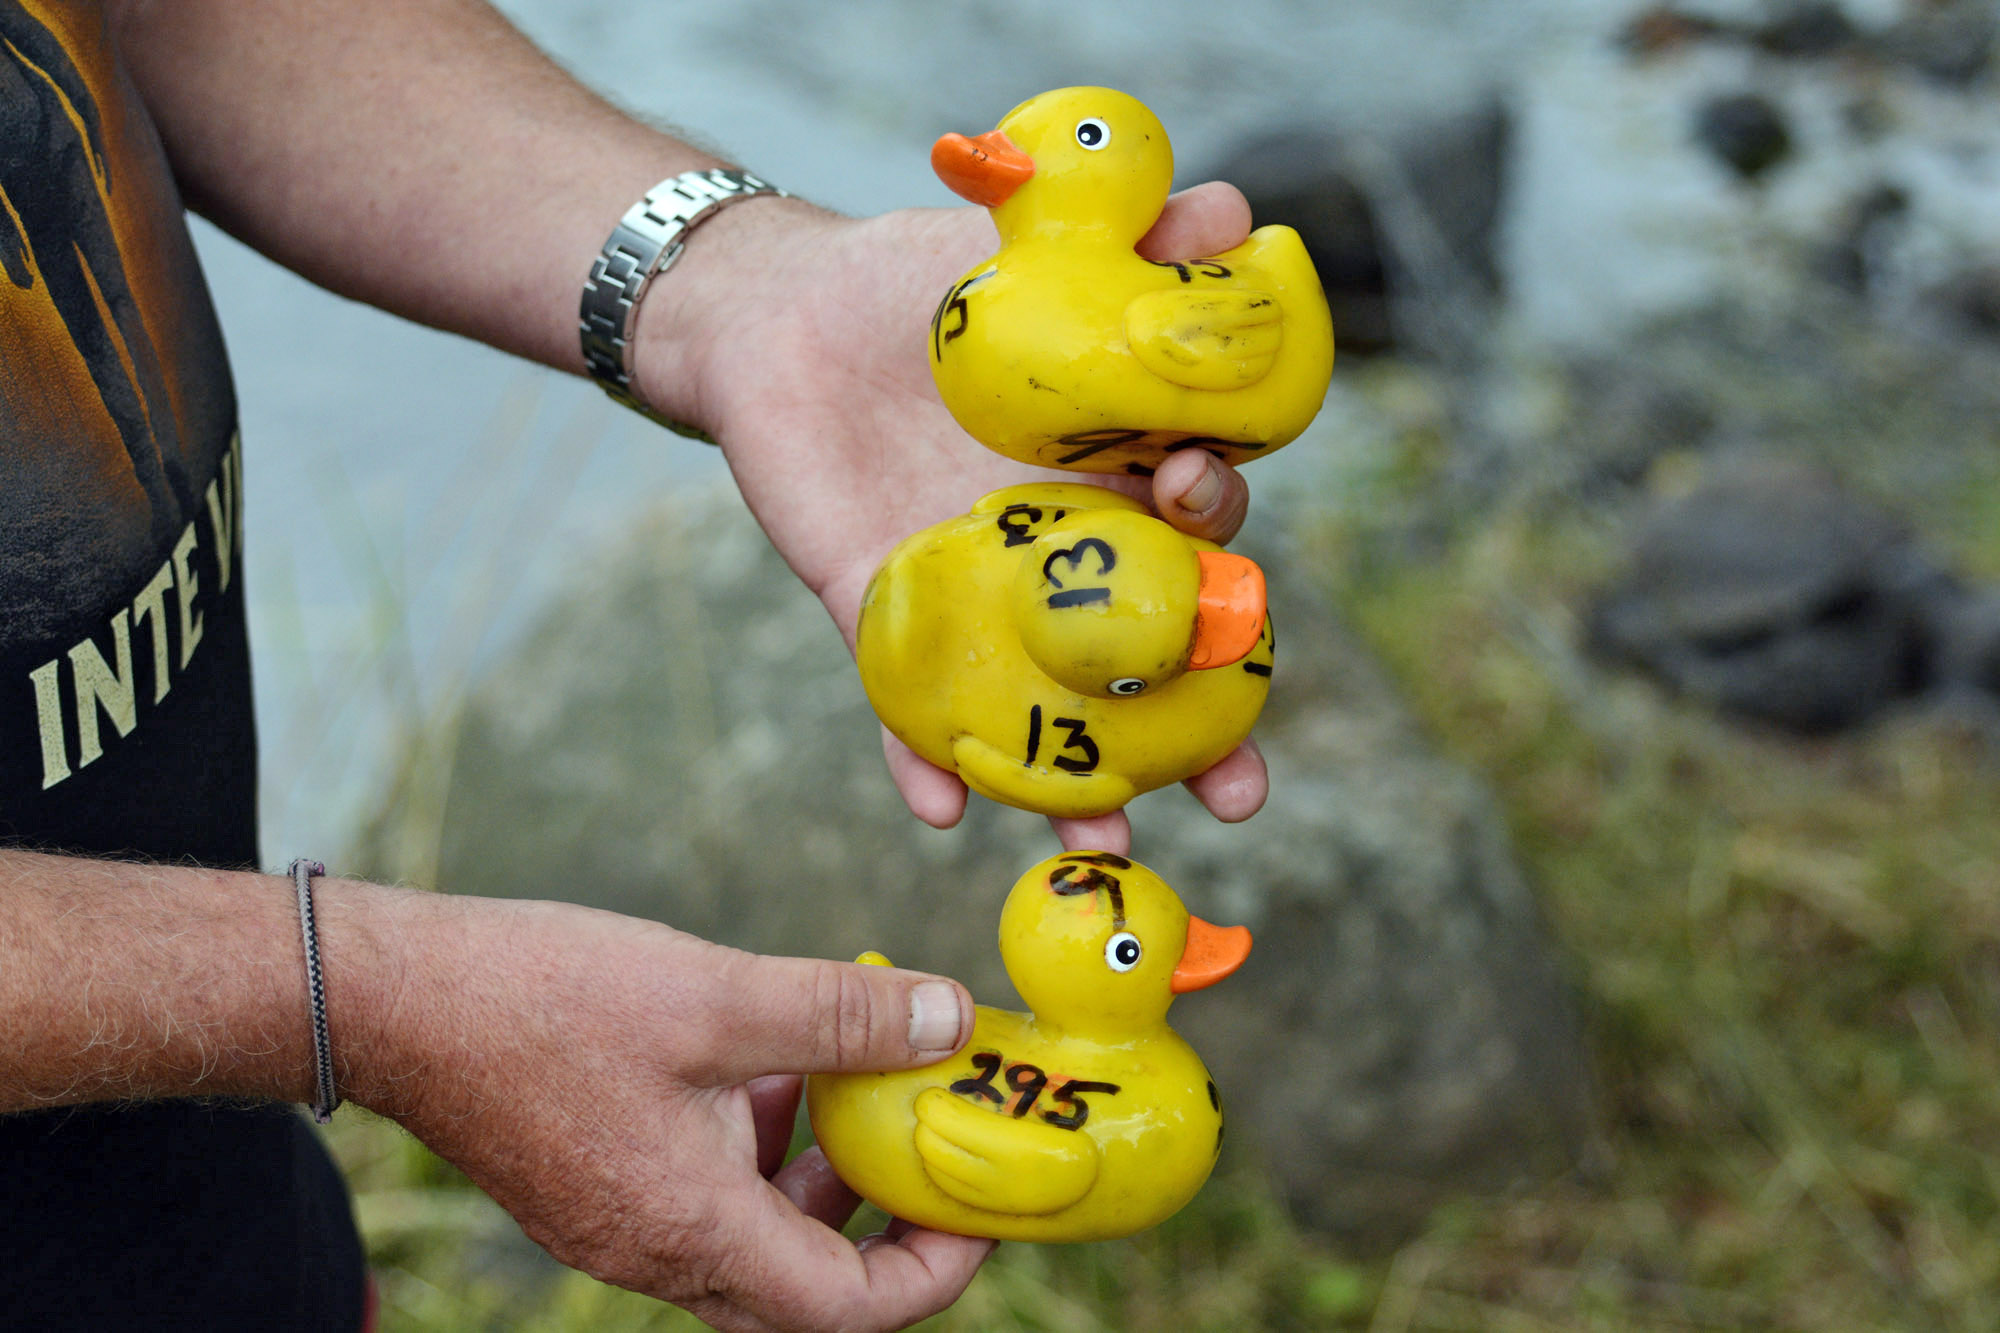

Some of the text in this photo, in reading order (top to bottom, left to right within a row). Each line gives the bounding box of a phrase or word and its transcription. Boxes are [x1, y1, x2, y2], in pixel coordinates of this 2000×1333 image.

[1043, 537, 1116, 609] 13
[29, 520, 204, 791] INTE
[1023, 704, 1100, 777] 13
[949, 1052, 1122, 1132] 295
